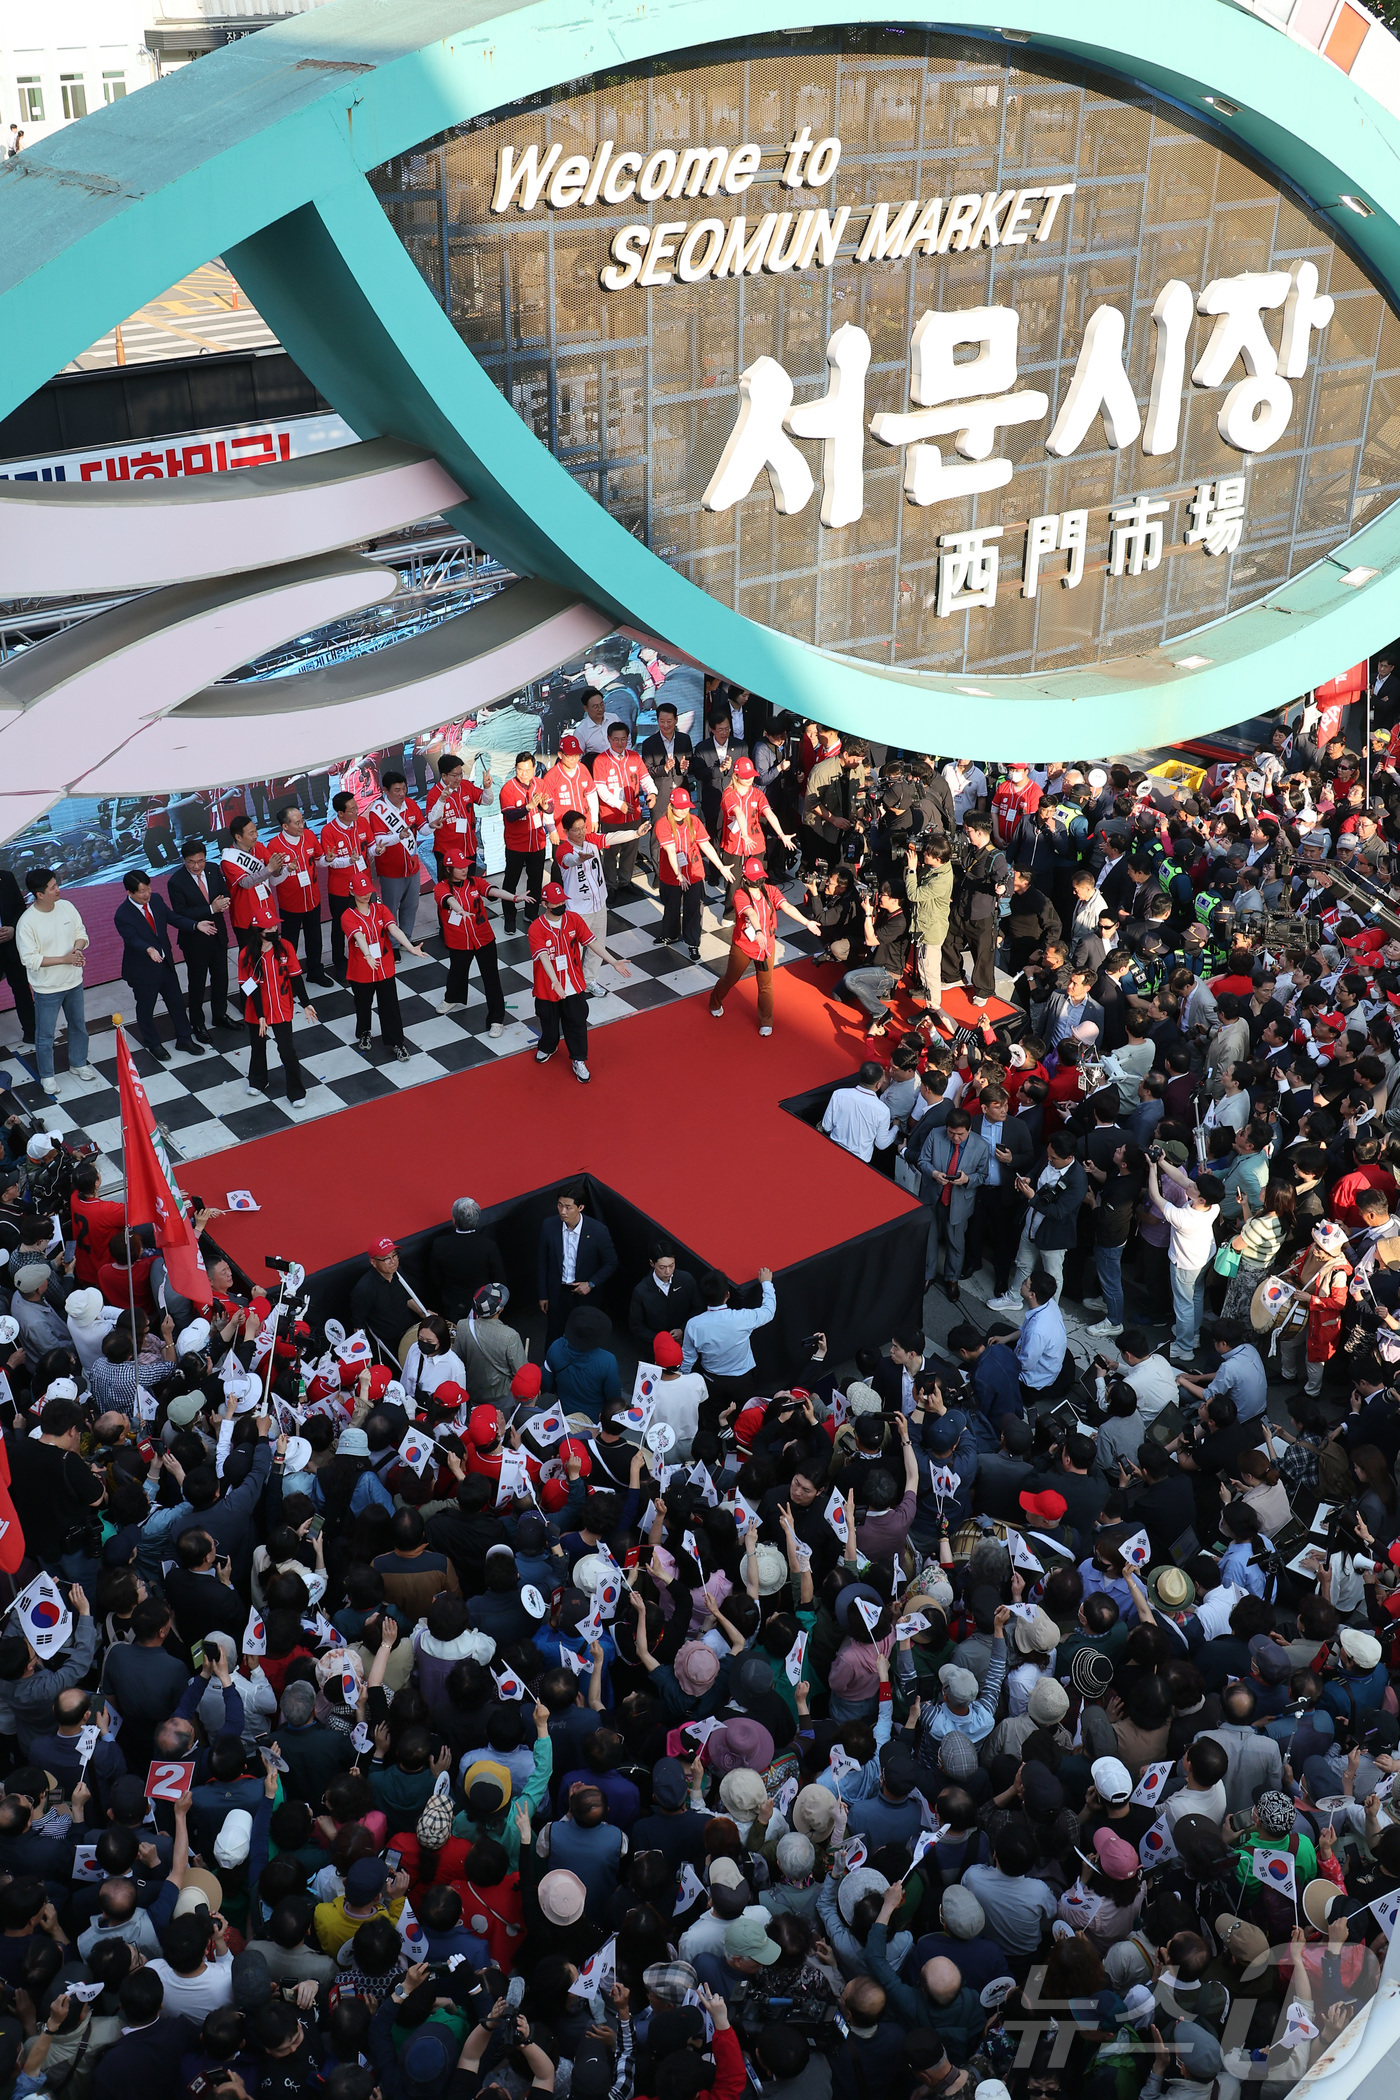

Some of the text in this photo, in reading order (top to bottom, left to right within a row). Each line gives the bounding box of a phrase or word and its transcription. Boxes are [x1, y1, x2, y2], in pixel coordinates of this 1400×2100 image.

[491, 127, 841, 213] Welcome to
[601, 183, 1077, 291] SEOMUN MARKET
[701, 260, 1334, 528] 서문시장
[937, 477, 1247, 617] 西門市場
[375, 803, 388, 815] 2
[74, 1213, 91, 1254] 2
[152, 1764, 186, 1799] 2
